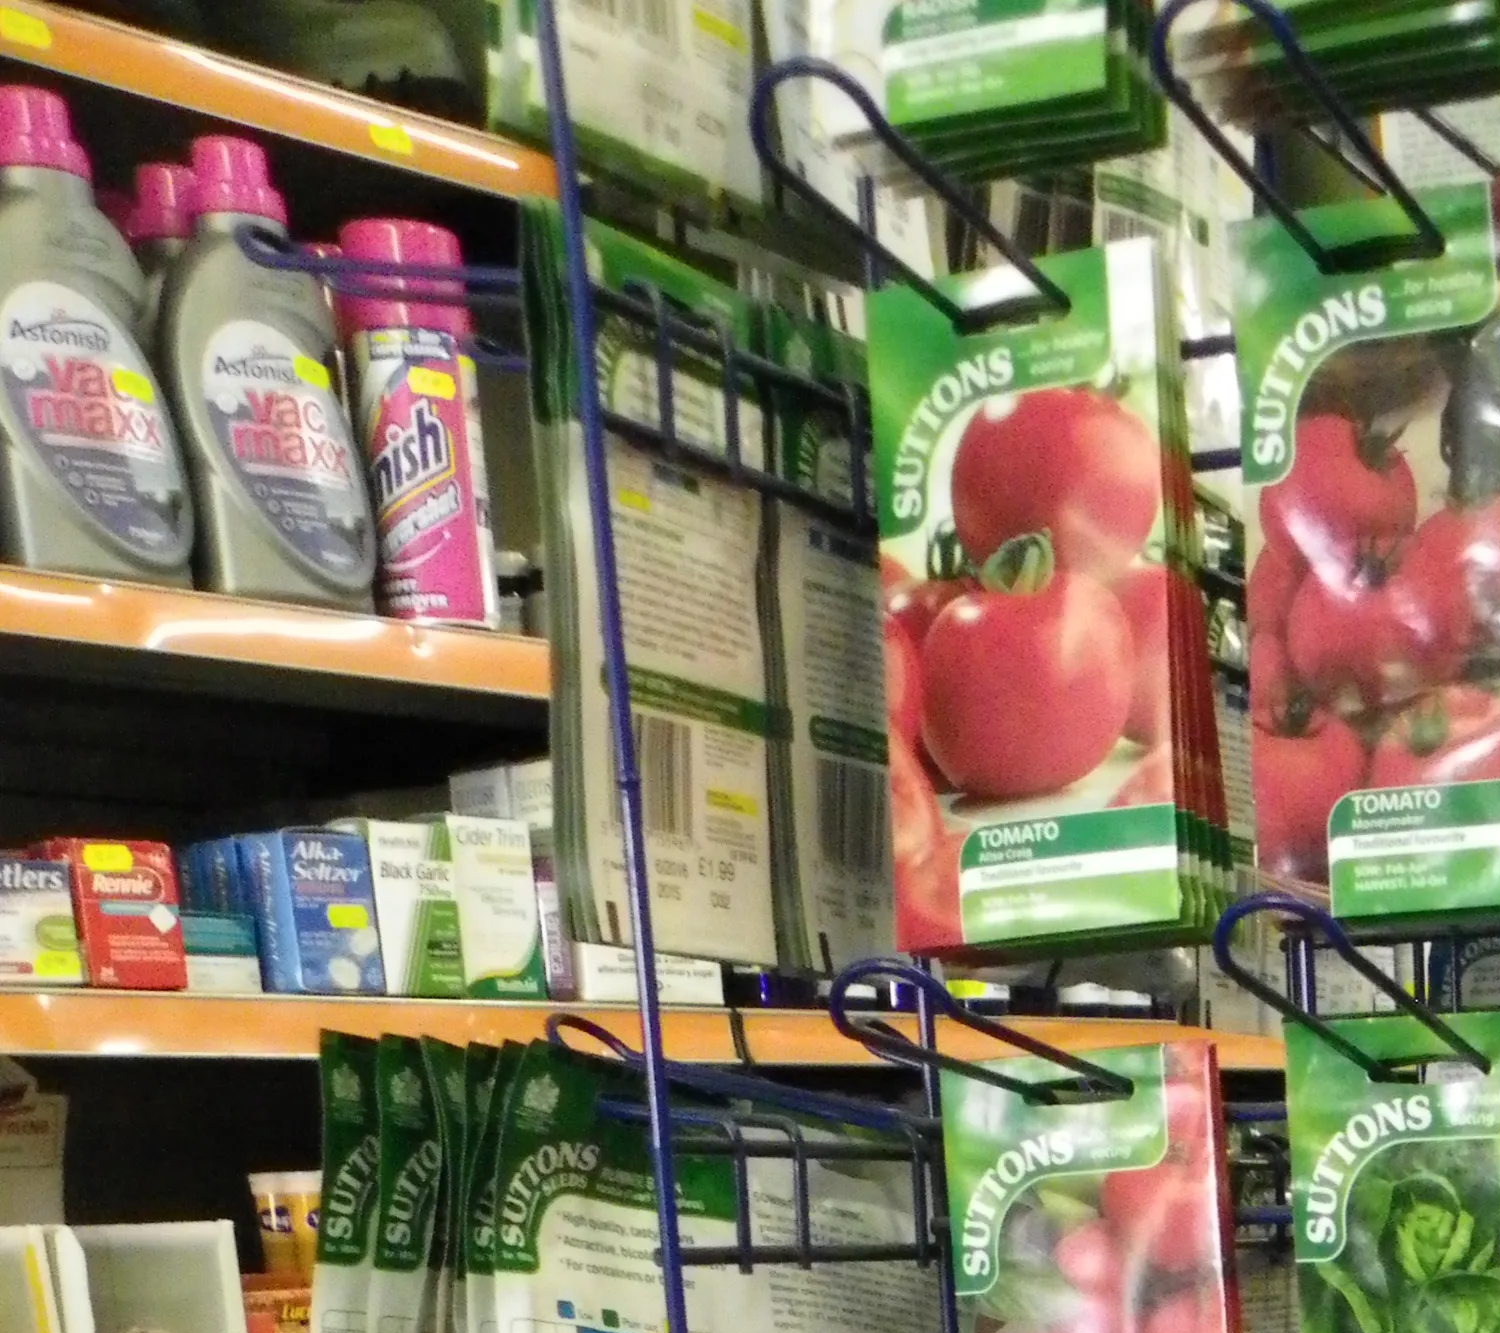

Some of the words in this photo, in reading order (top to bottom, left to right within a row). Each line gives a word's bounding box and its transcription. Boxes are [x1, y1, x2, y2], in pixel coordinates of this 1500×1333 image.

[9, 319, 109, 350] Astonish
[213, 352, 302, 383] Astonis
[1253, 284, 1387, 466] SUTTONS
[30, 384, 161, 447] maxx
[245, 386, 326, 434] vac
[231, 420, 348, 474] maxx
[893, 346, 1014, 520] SUTTONS
[1352, 789, 1441, 815] TOMATO
[456, 827, 492, 847] Cider
[497, 829, 527, 848] Trim
[979, 820, 1060, 848] TOMATO
[93, 873, 153, 896] Rennie
[292, 861, 366, 885] Seltzer
[380, 861, 412, 881] Black
[416, 863, 450, 882] Garlic
[1306, 1094, 1432, 1244] SUTTONS
[501, 1140, 600, 1248] SUTTONS
[962, 1131, 1075, 1277] SUTTONS
